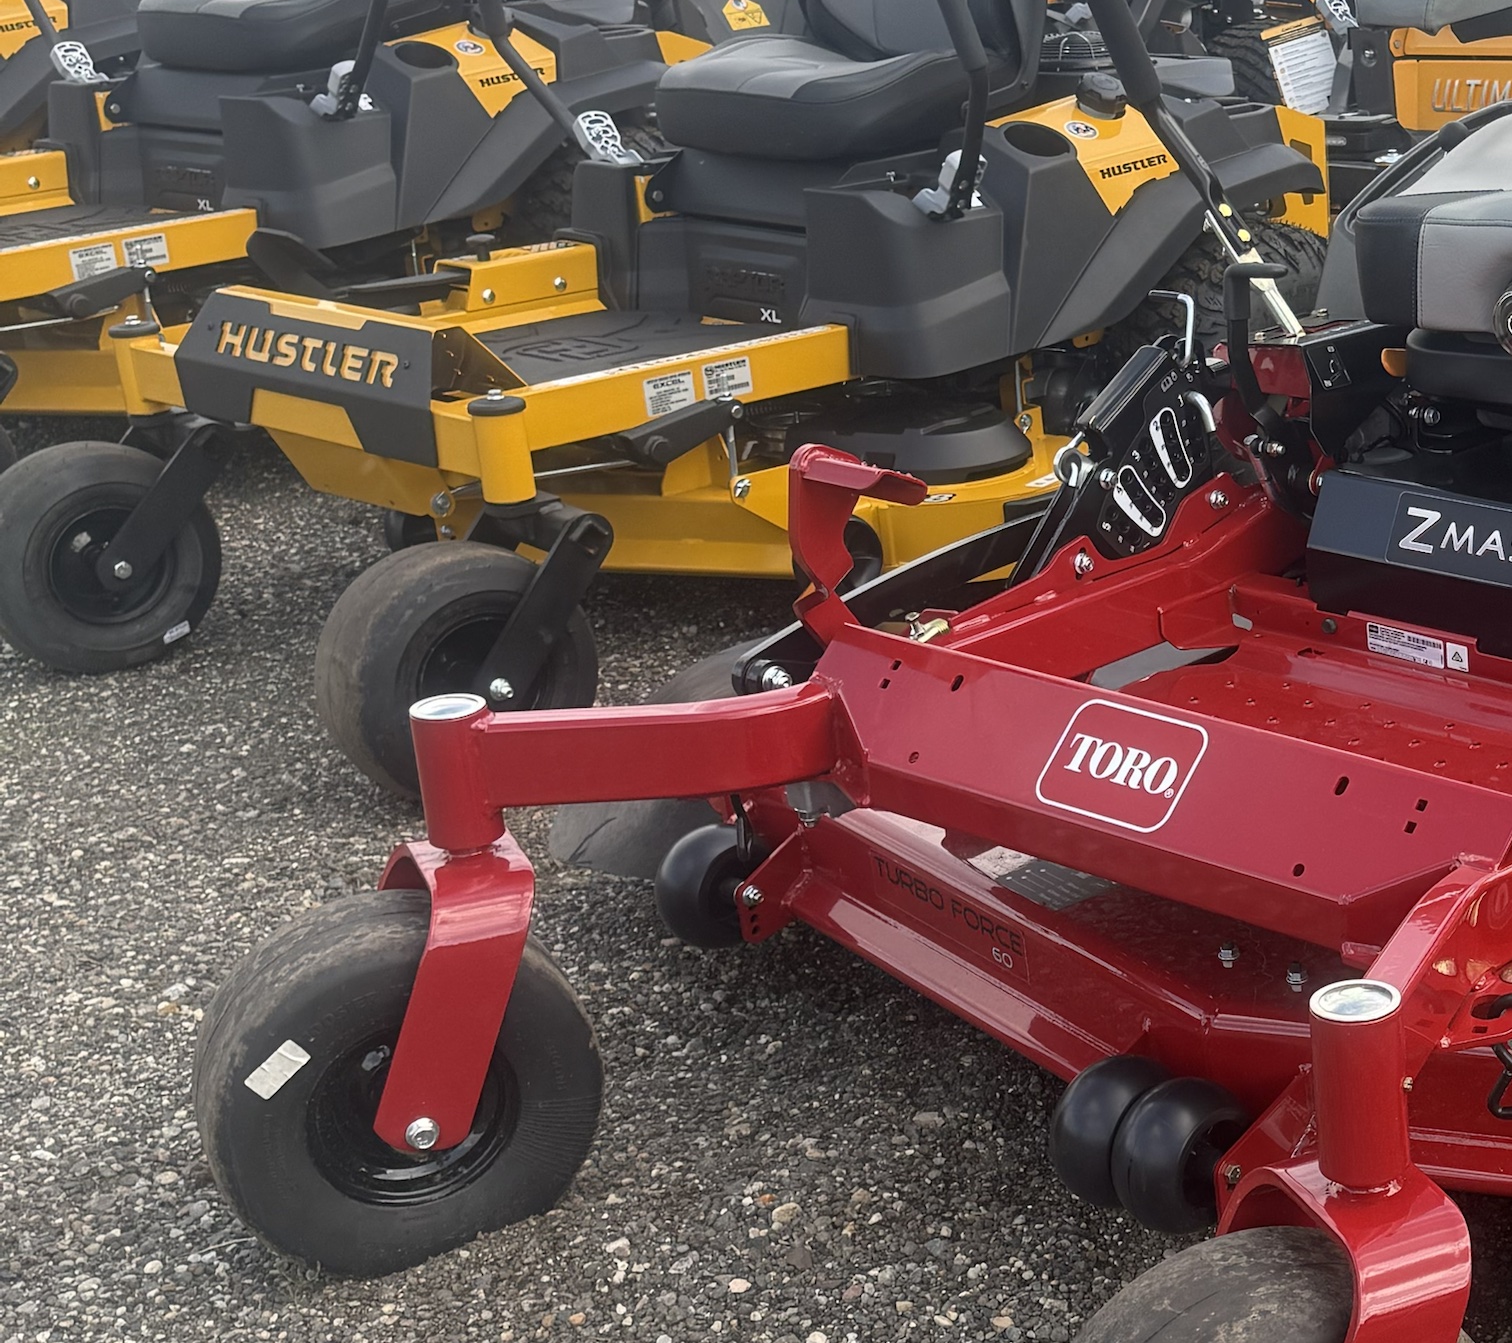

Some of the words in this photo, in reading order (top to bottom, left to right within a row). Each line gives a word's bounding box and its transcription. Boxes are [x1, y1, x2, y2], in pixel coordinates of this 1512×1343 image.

[1099, 154, 1168, 179] HUSTLER
[197, 199, 214, 212] XL
[760, 307, 782, 324] XL
[216, 321, 399, 388] HUSTLER
[1399, 506, 1442, 554] Z
[1063, 732, 1178, 795] TORO
[874, 855, 944, 911] TURBO
[951, 898, 1023, 957] FORCE
[992, 947, 1013, 969] 60
